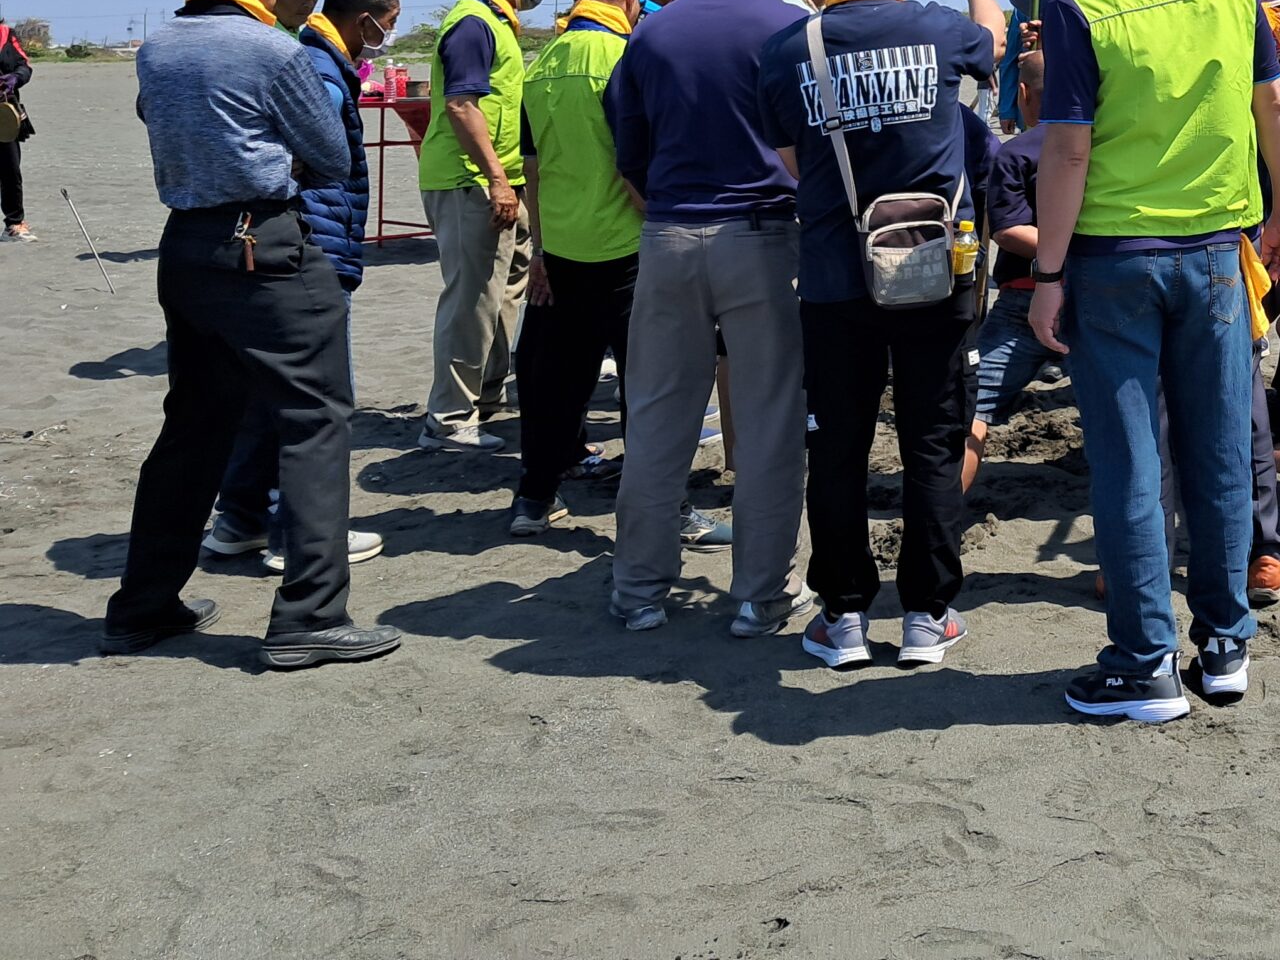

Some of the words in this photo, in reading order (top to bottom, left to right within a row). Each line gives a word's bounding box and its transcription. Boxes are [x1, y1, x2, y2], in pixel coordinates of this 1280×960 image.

[840, 100, 919, 121] 映攝影工作室
[1106, 677, 1124, 687] FILA
